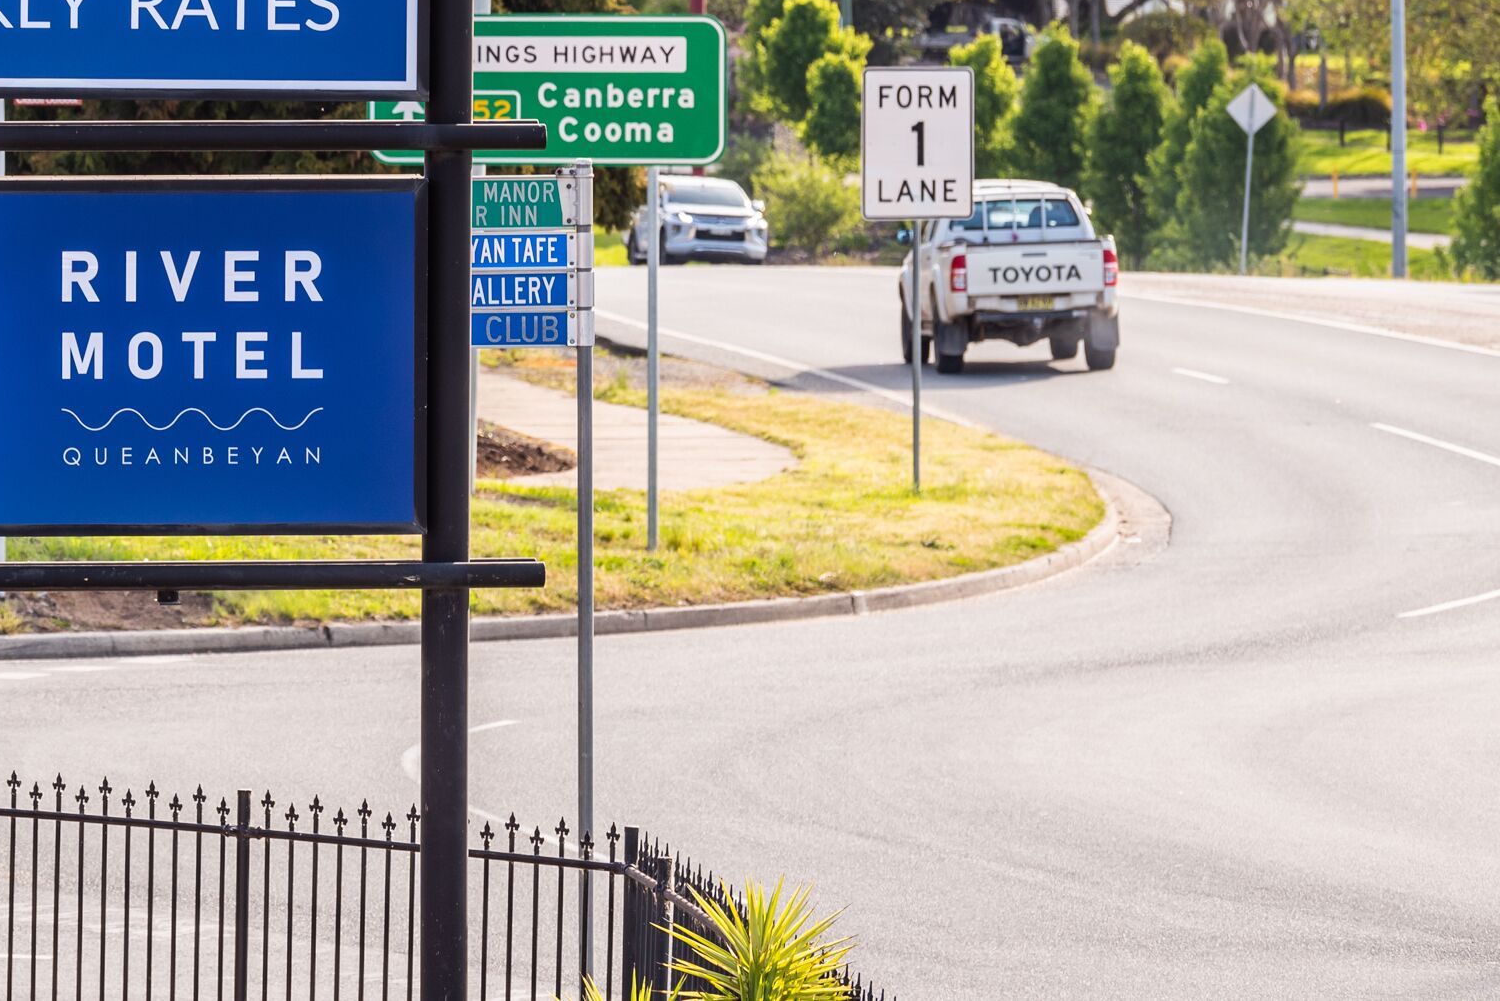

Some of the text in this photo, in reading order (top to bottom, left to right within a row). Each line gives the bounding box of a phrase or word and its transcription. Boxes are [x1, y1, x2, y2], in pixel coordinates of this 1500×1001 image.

[476, 45, 675, 64] INGS HIGHWAY
[537, 81, 695, 109] Canberra
[878, 84, 957, 109] FORM
[473, 99, 512, 120] 52
[558, 116, 674, 143] Cooma
[910, 120, 925, 167] 1
[483, 181, 555, 204] MANOR
[878, 179, 958, 203] LANE
[475, 204, 538, 227] R INN
[472, 236, 558, 264] YAN TAFE
[61, 250, 324, 303] RIVER
[988, 264, 1082, 285] TOYOTA
[472, 276, 556, 305] ALLERY
[485, 315, 559, 344] CLUB
[61, 331, 324, 380] MOTEL
[62, 446, 320, 467] QUEANBEYAN
